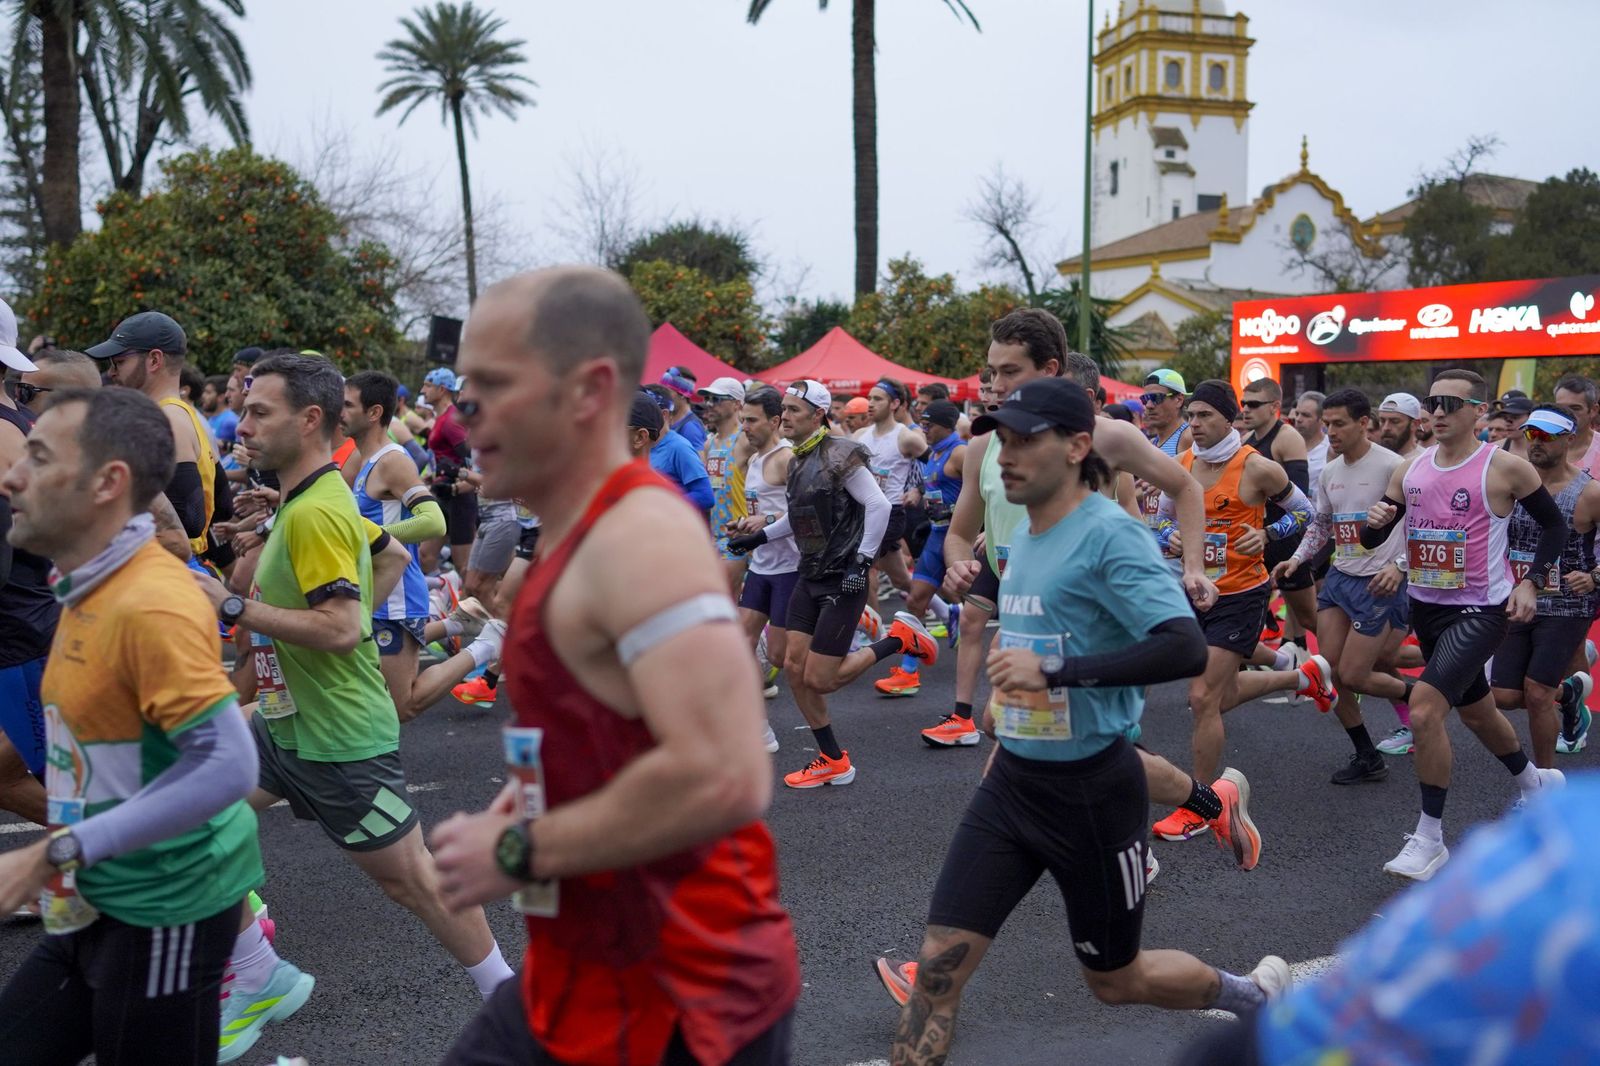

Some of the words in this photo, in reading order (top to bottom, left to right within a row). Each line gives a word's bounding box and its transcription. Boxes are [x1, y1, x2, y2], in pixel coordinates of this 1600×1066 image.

[1469, 305, 1542, 333] HOKA
[1146, 496, 1159, 509] 146
[1339, 524, 1358, 539] 531
[1419, 543, 1448, 562] 376
